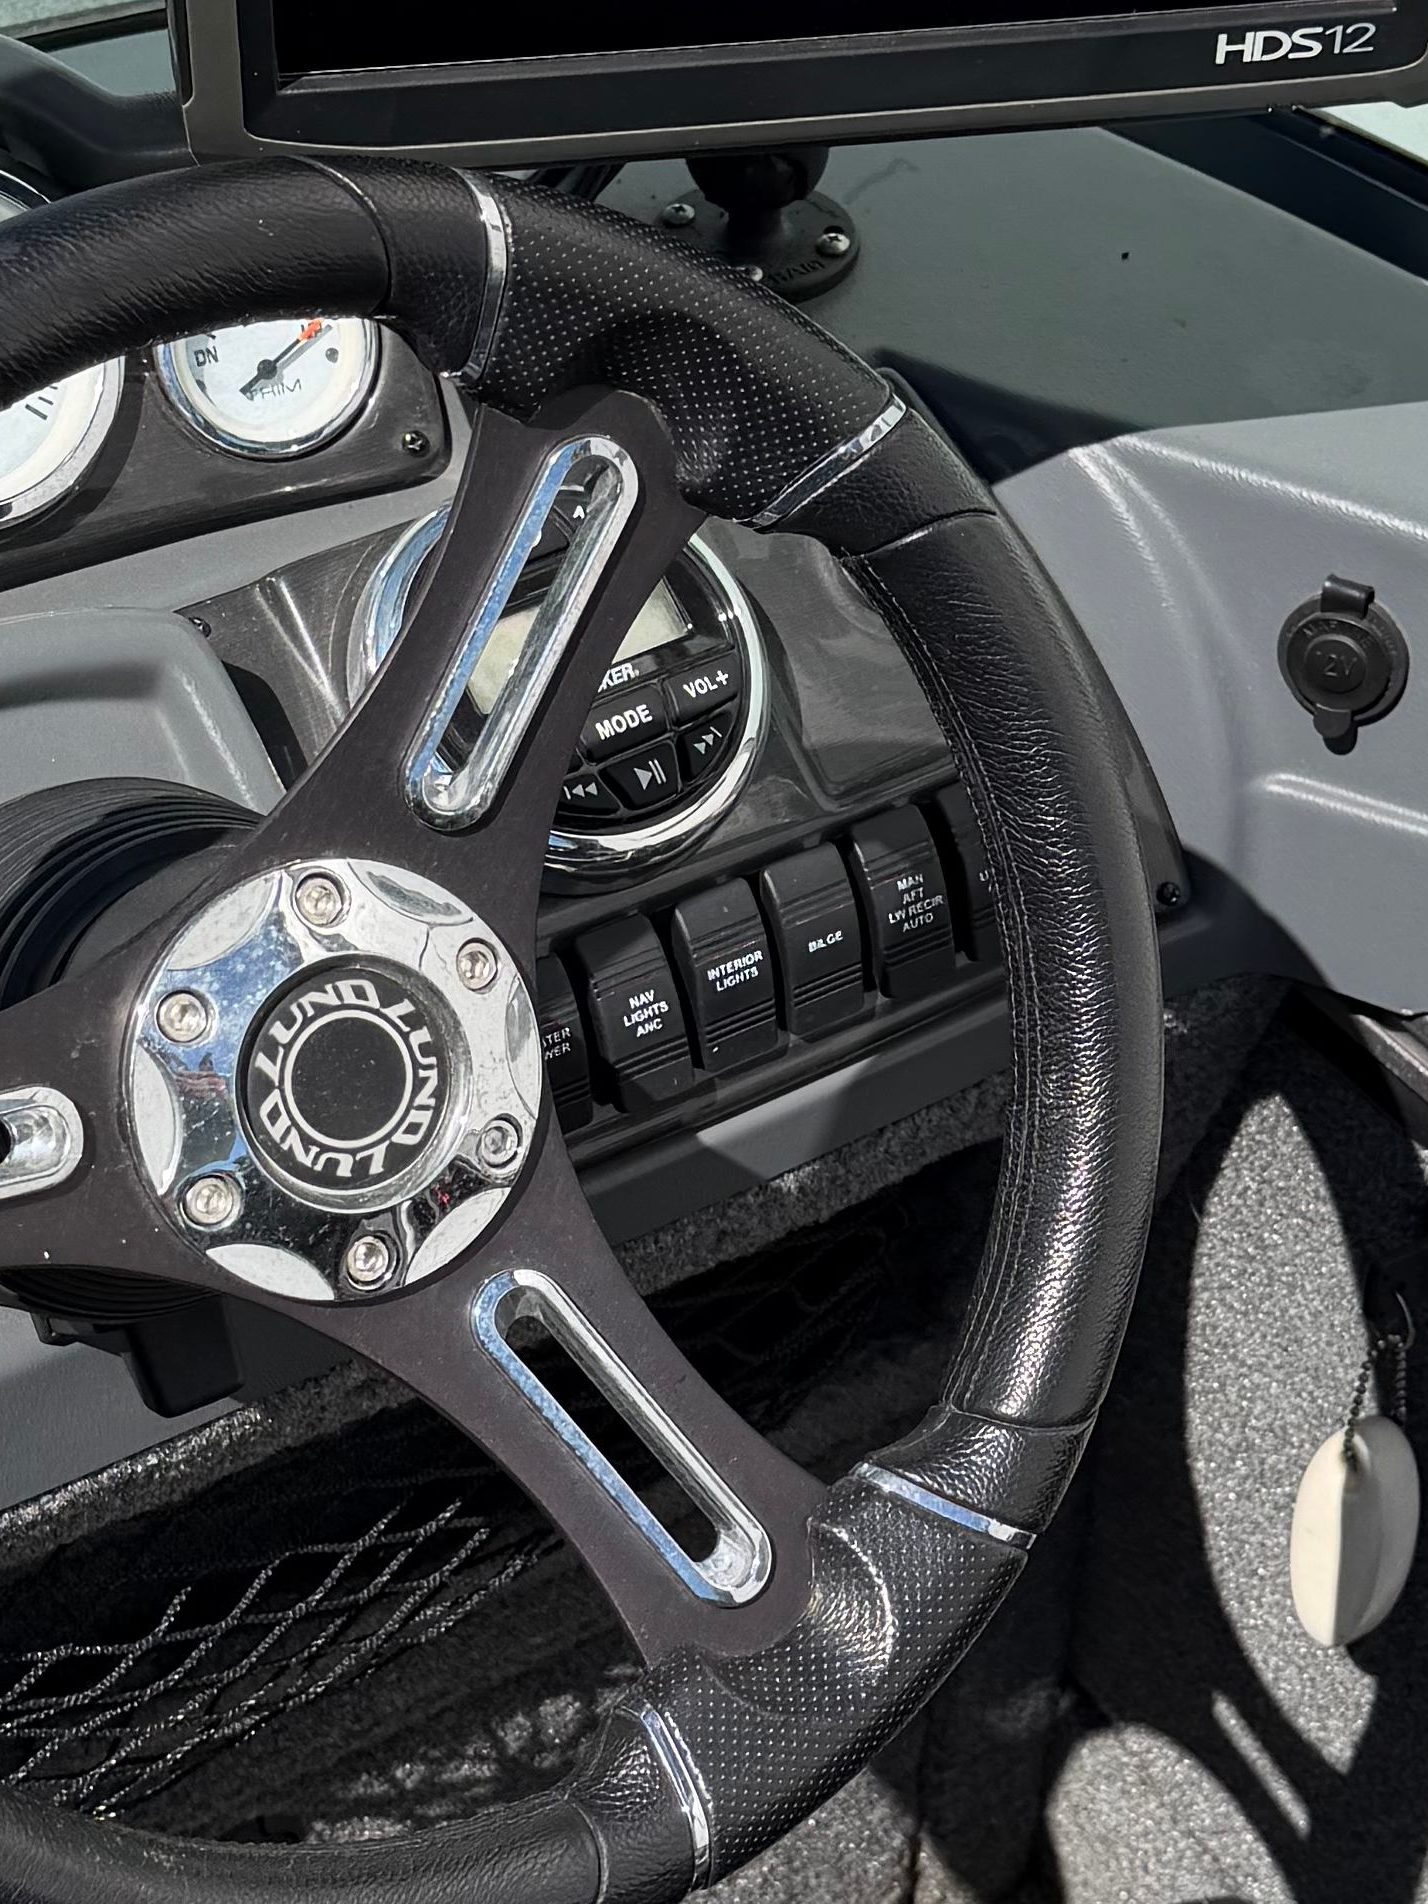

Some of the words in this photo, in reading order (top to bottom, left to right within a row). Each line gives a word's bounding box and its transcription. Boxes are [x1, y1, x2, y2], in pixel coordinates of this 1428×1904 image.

[1215, 22, 1376, 65] HDS12
[194, 347, 219, 367] DN
[683, 669, 729, 698] VOL+
[595, 704, 653, 740] MODE
[896, 873, 924, 891] MAN
[902, 887, 924, 904] AFT
[902, 912, 933, 933] AUTO
[707, 949, 763, 981] INTERIOR
[716, 966, 759, 992] LIGHTS
[628, 989, 656, 1010] NAV
[623, 1000, 669, 1028] LIGHTS
[636, 1017, 664, 1038] ANC
[256, 979, 378, 1084] LUND
[379, 998, 440, 1145] LUND
[260, 1089, 393, 1177] LUND
